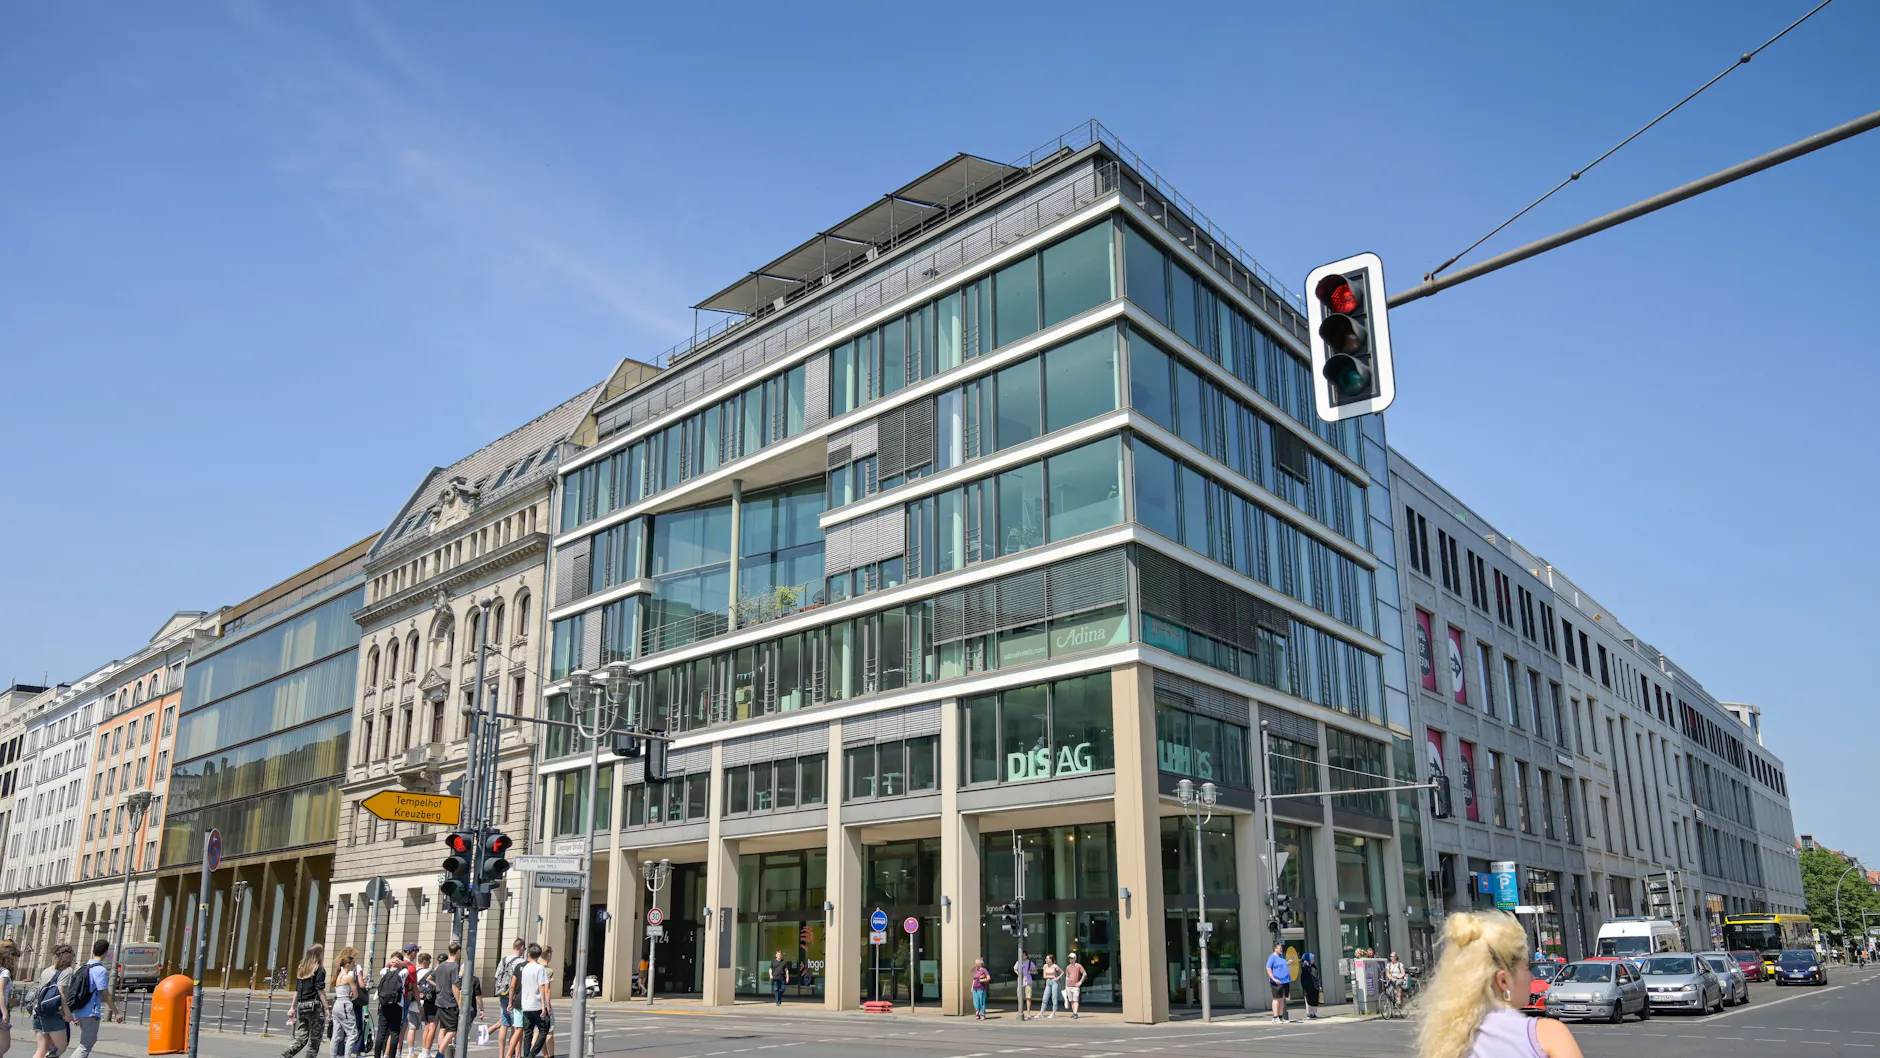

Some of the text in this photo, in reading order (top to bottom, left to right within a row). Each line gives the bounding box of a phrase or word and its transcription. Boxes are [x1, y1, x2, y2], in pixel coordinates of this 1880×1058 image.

[1056, 626, 1106, 648] Adina
[1003, 646, 1047, 660] adinahotels.com
[1007, 742, 1093, 782] DIS AG
[395, 795, 443, 808] Tempelhof
[393, 807, 441, 822] Kreuzberg
[539, 875, 578, 885] Wilhelmstraße
[651, 912, 660, 921] 30
[807, 959, 824, 971] togo
